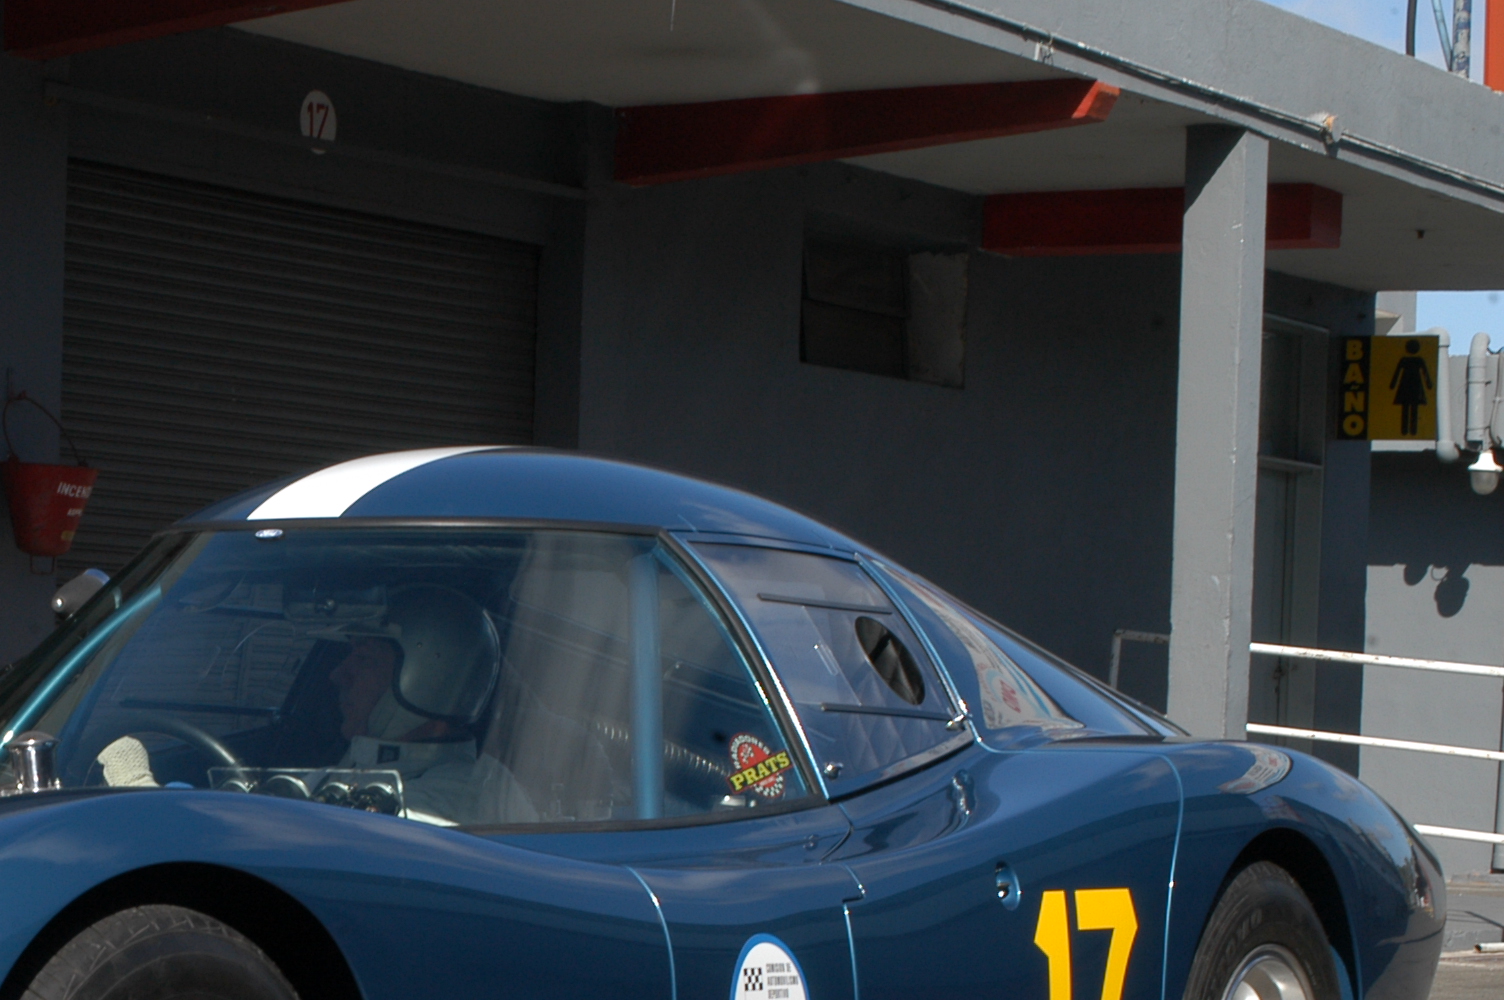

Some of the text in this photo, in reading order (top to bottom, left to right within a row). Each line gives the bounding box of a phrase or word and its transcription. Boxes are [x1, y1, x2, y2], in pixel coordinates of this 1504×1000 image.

[307, 101, 329, 138] 17
[1342, 339, 1365, 436] BAÑO
[729, 751, 790, 791] PRATS
